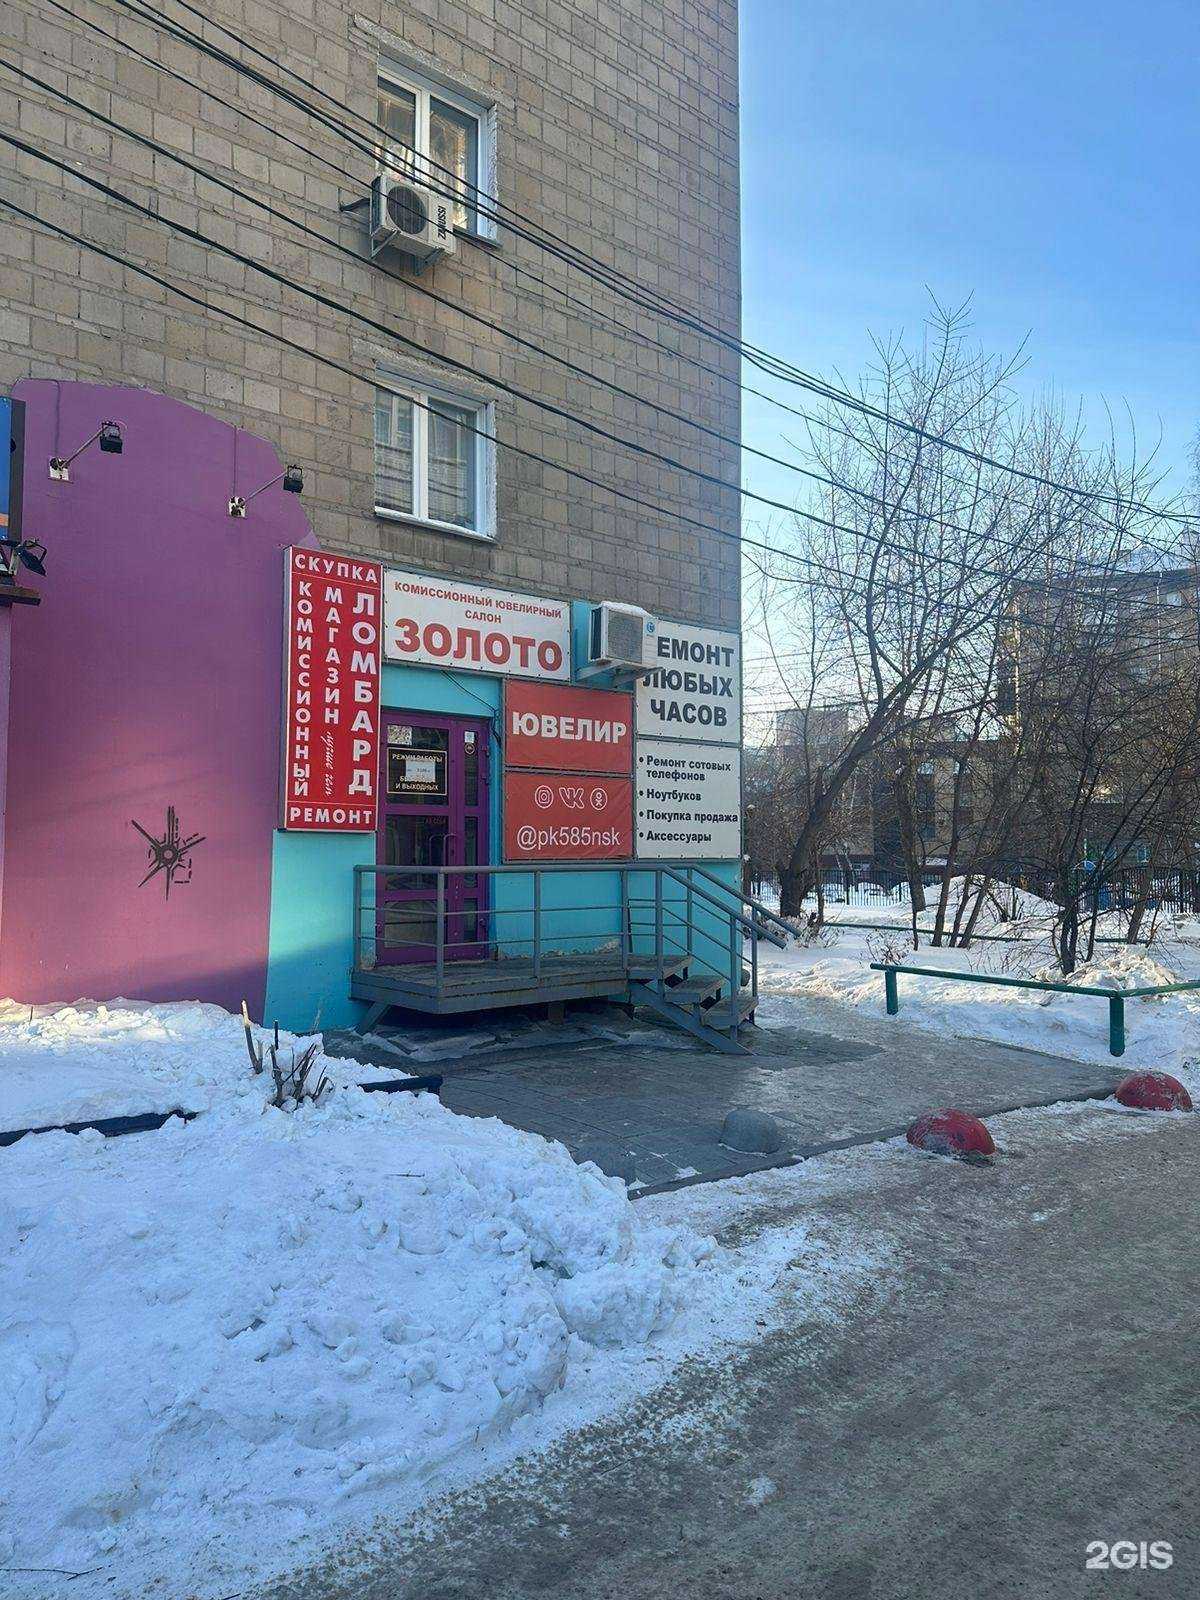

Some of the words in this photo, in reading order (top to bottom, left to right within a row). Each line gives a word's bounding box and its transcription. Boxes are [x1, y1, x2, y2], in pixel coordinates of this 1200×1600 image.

[294, 553, 378, 584] СКУПКА
[394, 581, 493, 608] КОМИССИОННЫЙ
[495, 600, 562, 619] ЮВЕЛИРНЫЙ
[465, 609, 502, 624] САЛОН
[324, 586, 343, 725] МАГАЗИН
[394, 618, 563, 672] ЗОЛОТО
[657, 636, 735, 667] ЕМОНТ
[293, 581, 314, 797] КОМИССИОННЫЙ
[349, 592, 377, 797] ЛОМБАРД
[642, 667, 734, 698] ЛЮБЫХ
[511, 711, 627, 744] ЮВЕЛИР
[650, 699, 728, 727] ЧАСОВ
[646, 755, 686, 767] Ремонт
[689, 760, 731, 772] сотовых
[646, 769, 706, 781] телефонов
[646, 788, 702, 802] Ноутбуков
[290, 806, 373, 825] РЕМОНТ
[646, 809, 691, 823] Покупка
[694, 812, 738, 824] продажа
[517, 825, 621, 851] @pk585nsk
[646, 830, 712, 843] Аксессуары
